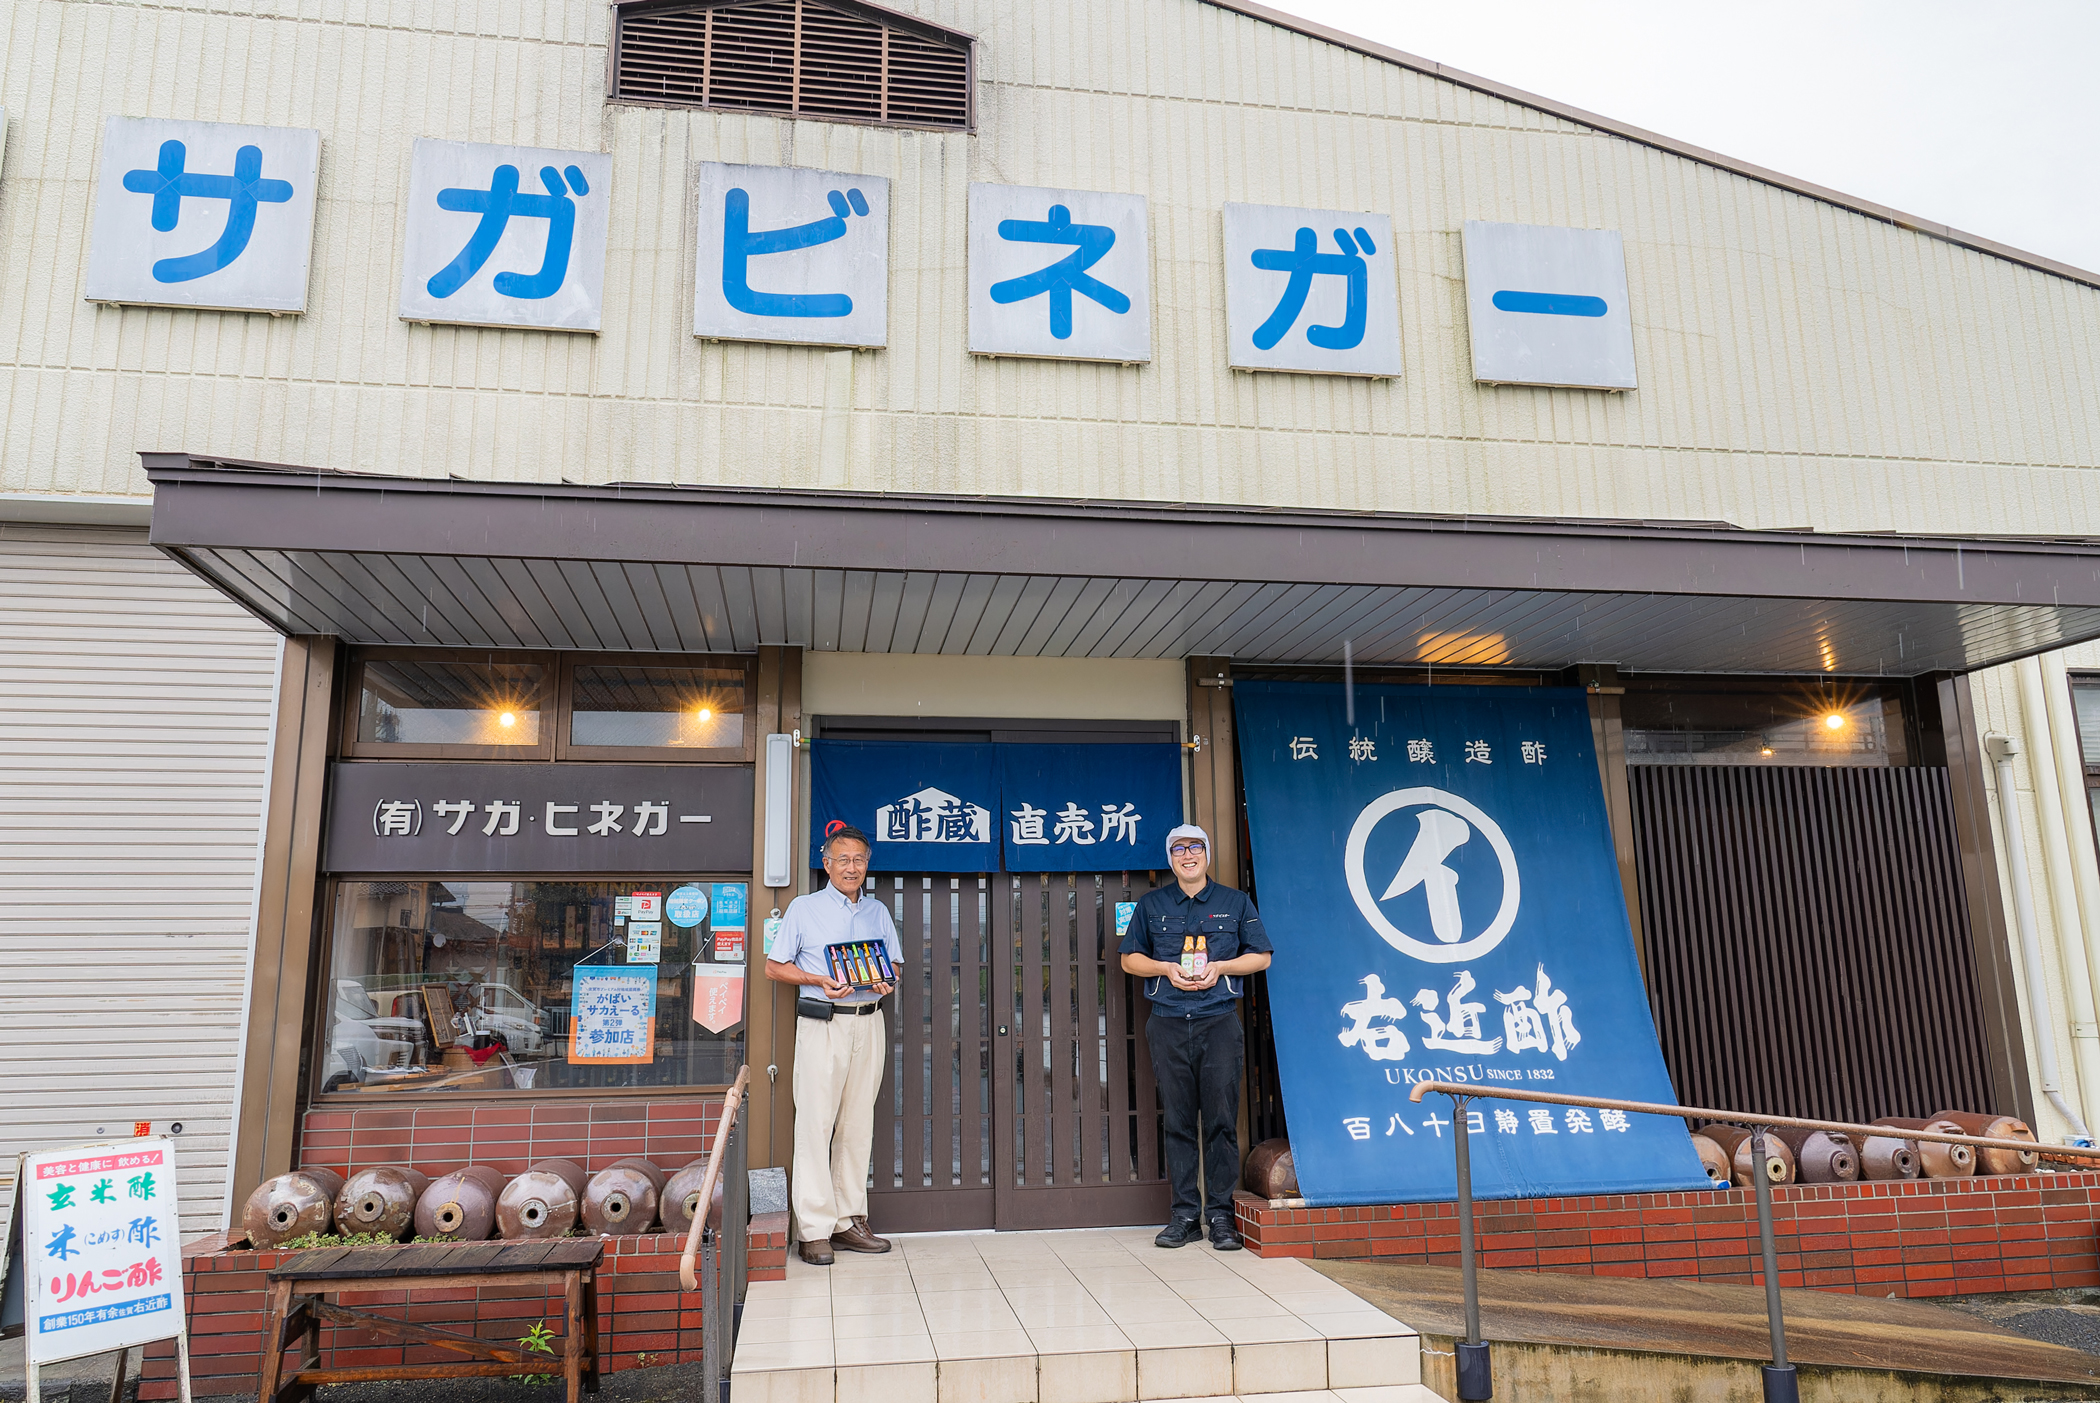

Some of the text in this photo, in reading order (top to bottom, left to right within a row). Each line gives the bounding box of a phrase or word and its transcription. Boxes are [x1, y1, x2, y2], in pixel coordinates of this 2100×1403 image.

[886, 797, 981, 842] 酢蔵
[1009, 801, 1143, 846] 直売所
[596, 993, 632, 1004] がばい
[718, 982, 729, 1014] ペイペイ
[602, 1018, 623, 1026] 第2弾
[1337, 962, 1581, 1062] 右近酢
[588, 1029, 635, 1044] 参加店
[1385, 1064, 1555, 1084] UKONSU SINCE 1832
[43, 1158, 112, 1177] 美容と健康に
[46, 1171, 156, 1211] 玄米酢
[50, 1256, 162, 1303] りんご酢
